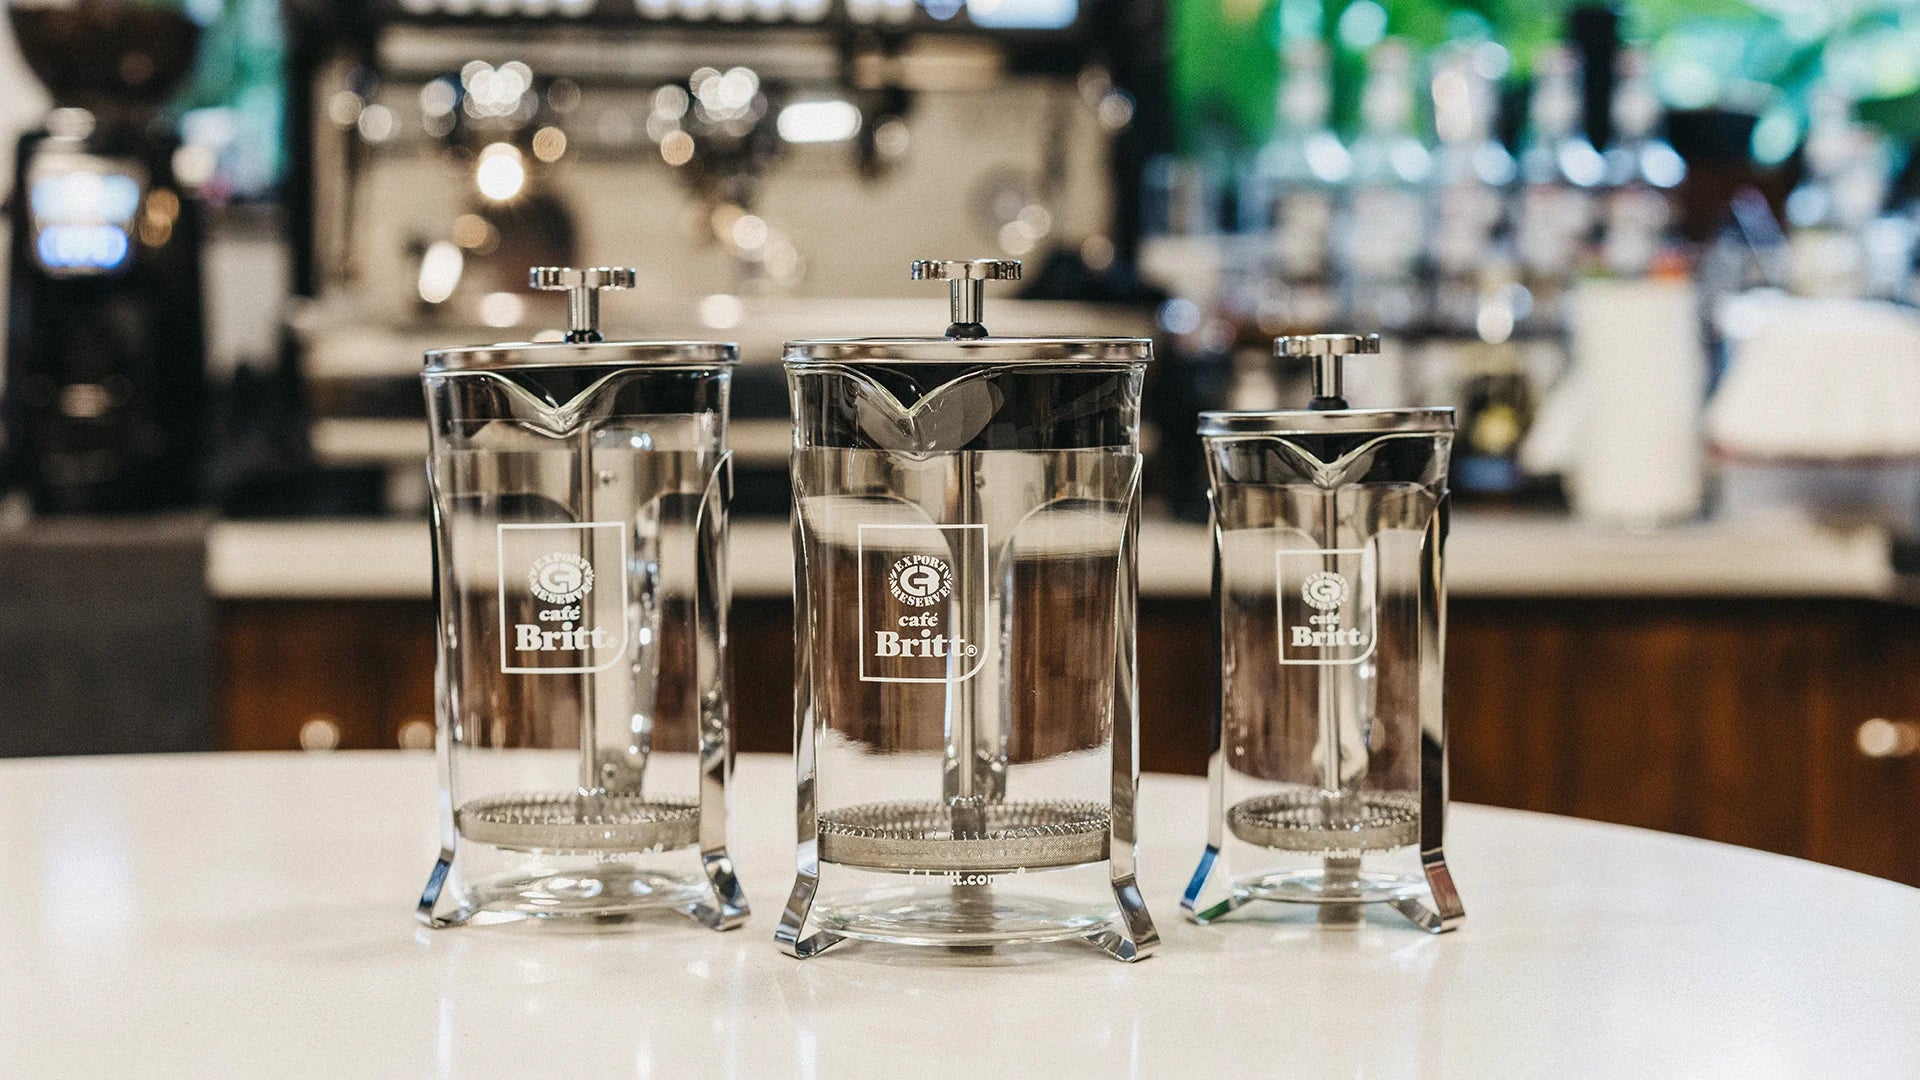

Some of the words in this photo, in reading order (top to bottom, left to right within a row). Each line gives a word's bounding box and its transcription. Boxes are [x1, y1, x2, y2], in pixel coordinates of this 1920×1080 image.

[893, 555, 948, 572] EXPORT
[891, 585, 950, 607] RESERVE
[538, 605, 581, 622] café
[898, 612, 939, 627] café
[1309, 611, 1341, 625] café
